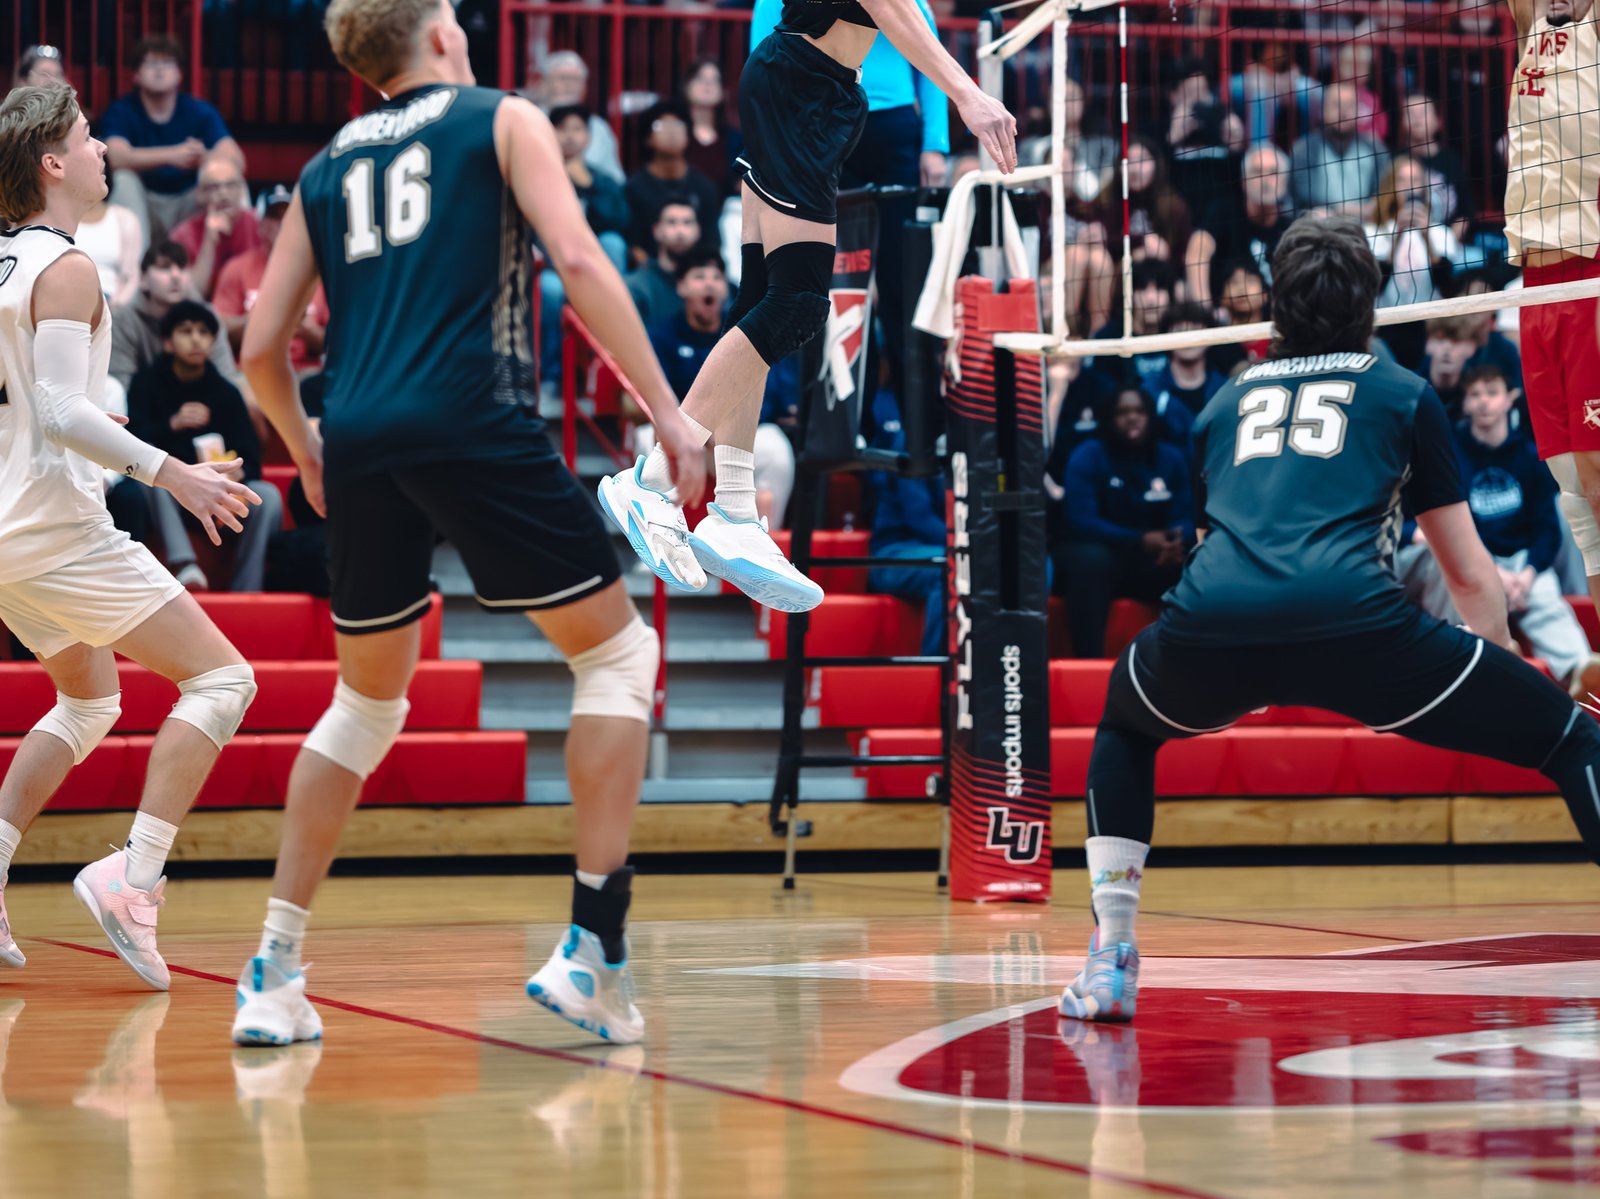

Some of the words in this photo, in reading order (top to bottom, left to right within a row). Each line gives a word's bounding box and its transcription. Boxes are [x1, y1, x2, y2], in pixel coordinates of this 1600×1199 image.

[342, 141, 432, 265] 16
[1233, 380, 1357, 468] 25
[1000, 645, 1024, 712] sports
[1001, 714, 1025, 798] imports
[985, 806, 1045, 865] LU
